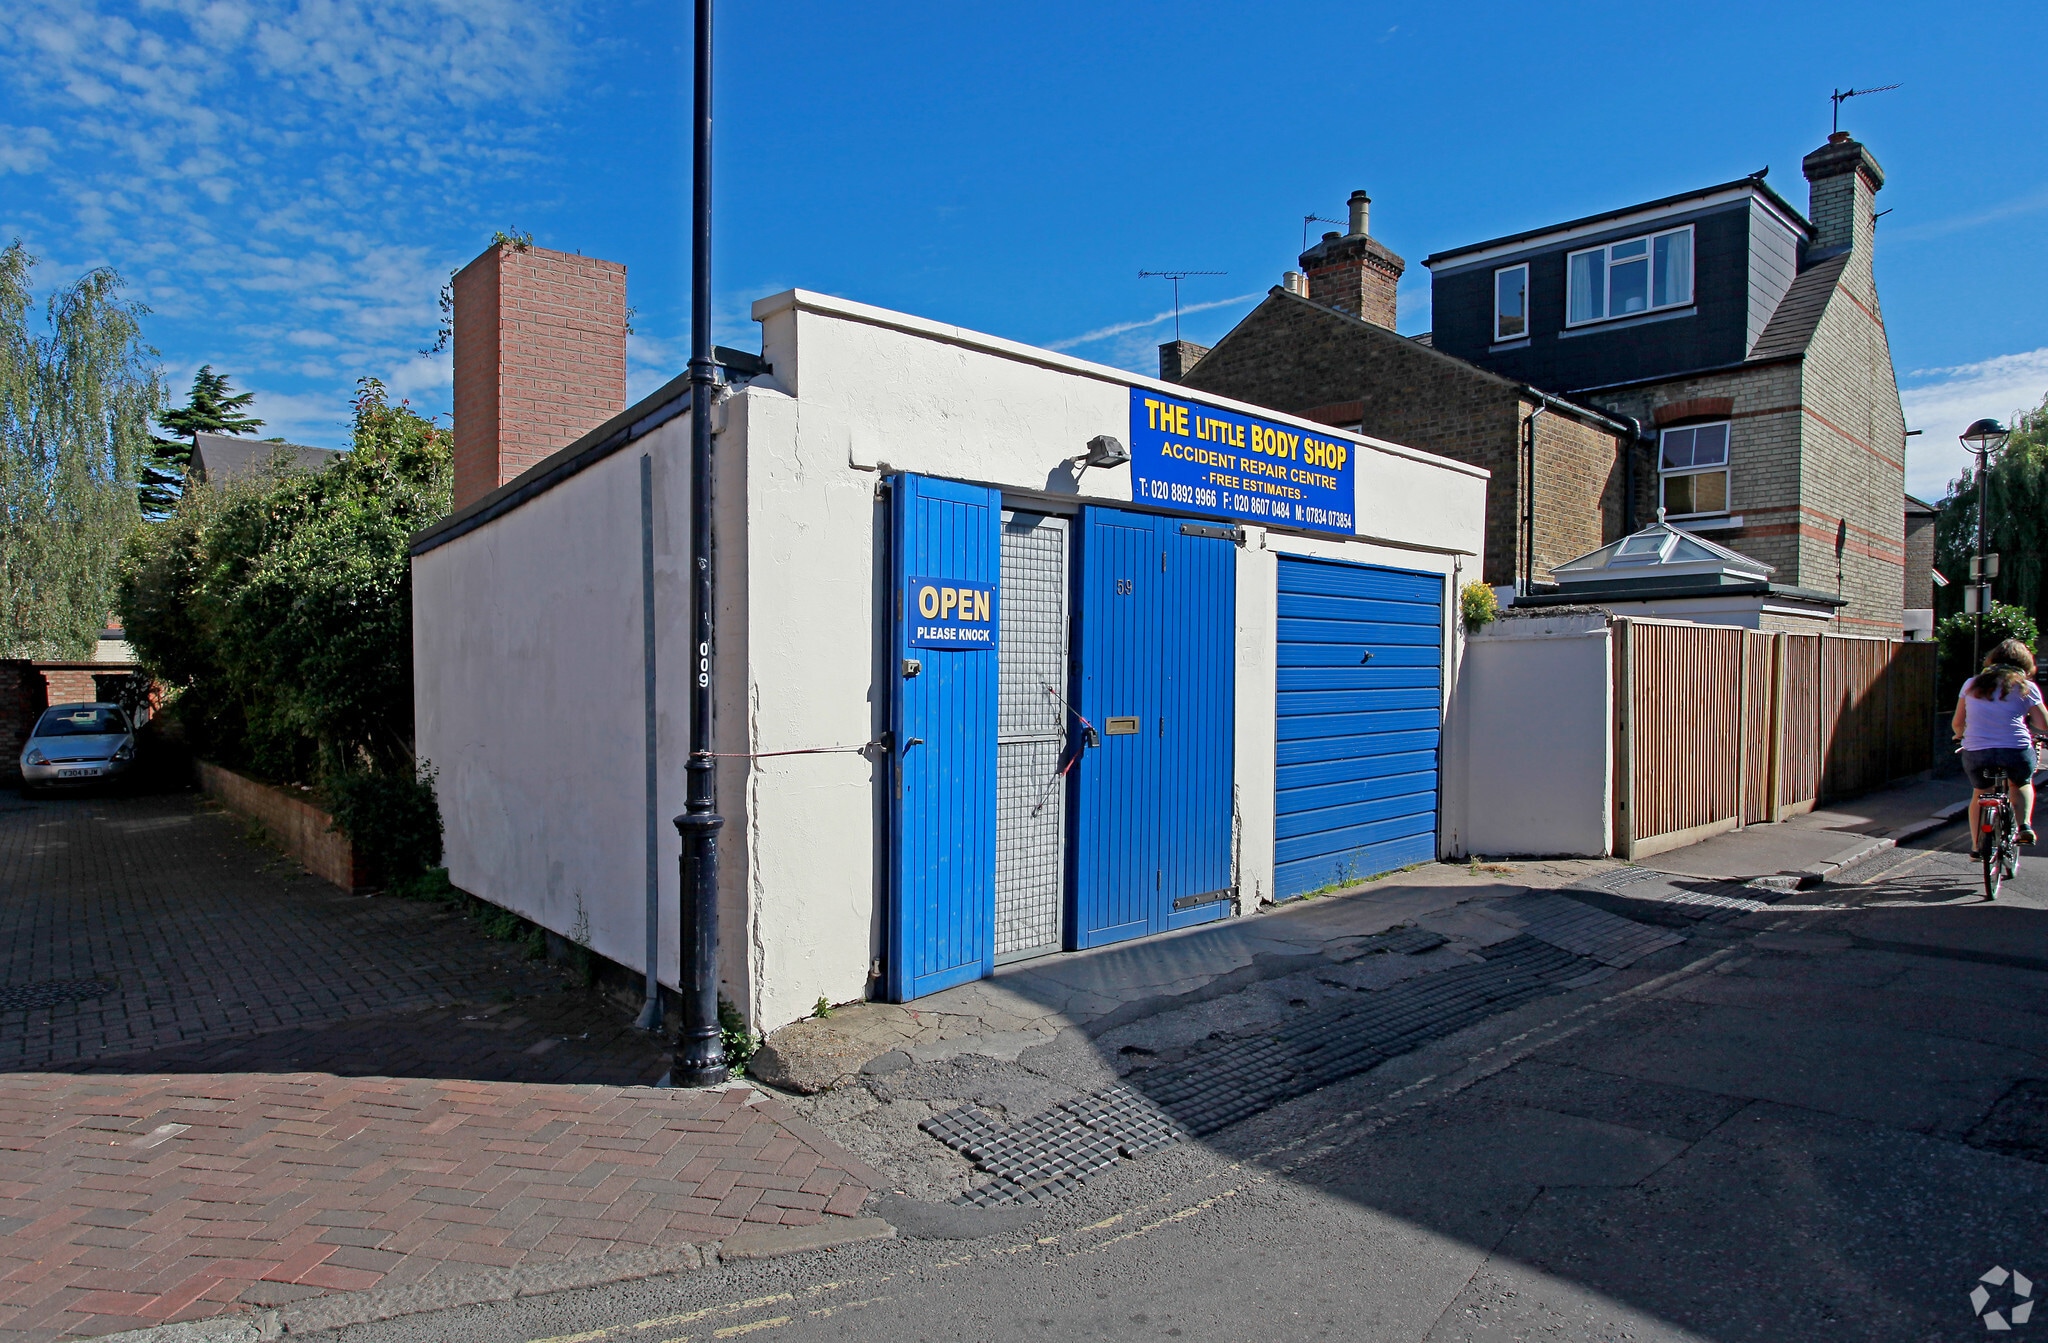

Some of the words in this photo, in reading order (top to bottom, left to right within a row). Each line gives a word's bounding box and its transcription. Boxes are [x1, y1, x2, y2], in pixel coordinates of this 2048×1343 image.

[1144, 398, 1190, 437] THE
[1196, 415, 1246, 449] LITTLE
[1251, 424, 1300, 461] BODY
[1303, 437, 1347, 471] SHOP
[1161, 441, 1237, 470] ACCIDENT
[1240, 457, 1288, 481] REPAIR
[1290, 468, 1337, 491] CENTRE
[1209, 471, 1241, 490] FREE
[1242, 478, 1301, 500] ESTIMATES
[1139, 477, 1149, 497] T:
[1151, 479, 1169, 500] 020
[1171, 482, 1193, 504] 8892
[1195, 487, 1217, 508] 9966
[1223, 491, 1232, 510] F:
[1234, 493, 1249, 513] 020
[1251, 496, 1270, 516] 8607
[1271, 500, 1290, 519] 0484
[1295, 504, 1304, 522] M:
[1306, 506, 1327, 525] 07834
[1328, 510, 1352, 529] 073854
[918, 585, 991, 623] OPEN
[1116, 579, 1133, 596] 59
[917, 626, 957, 640] PLEASE
[958, 628, 990, 642] KNOCK
[698, 642, 709, 688] 009
